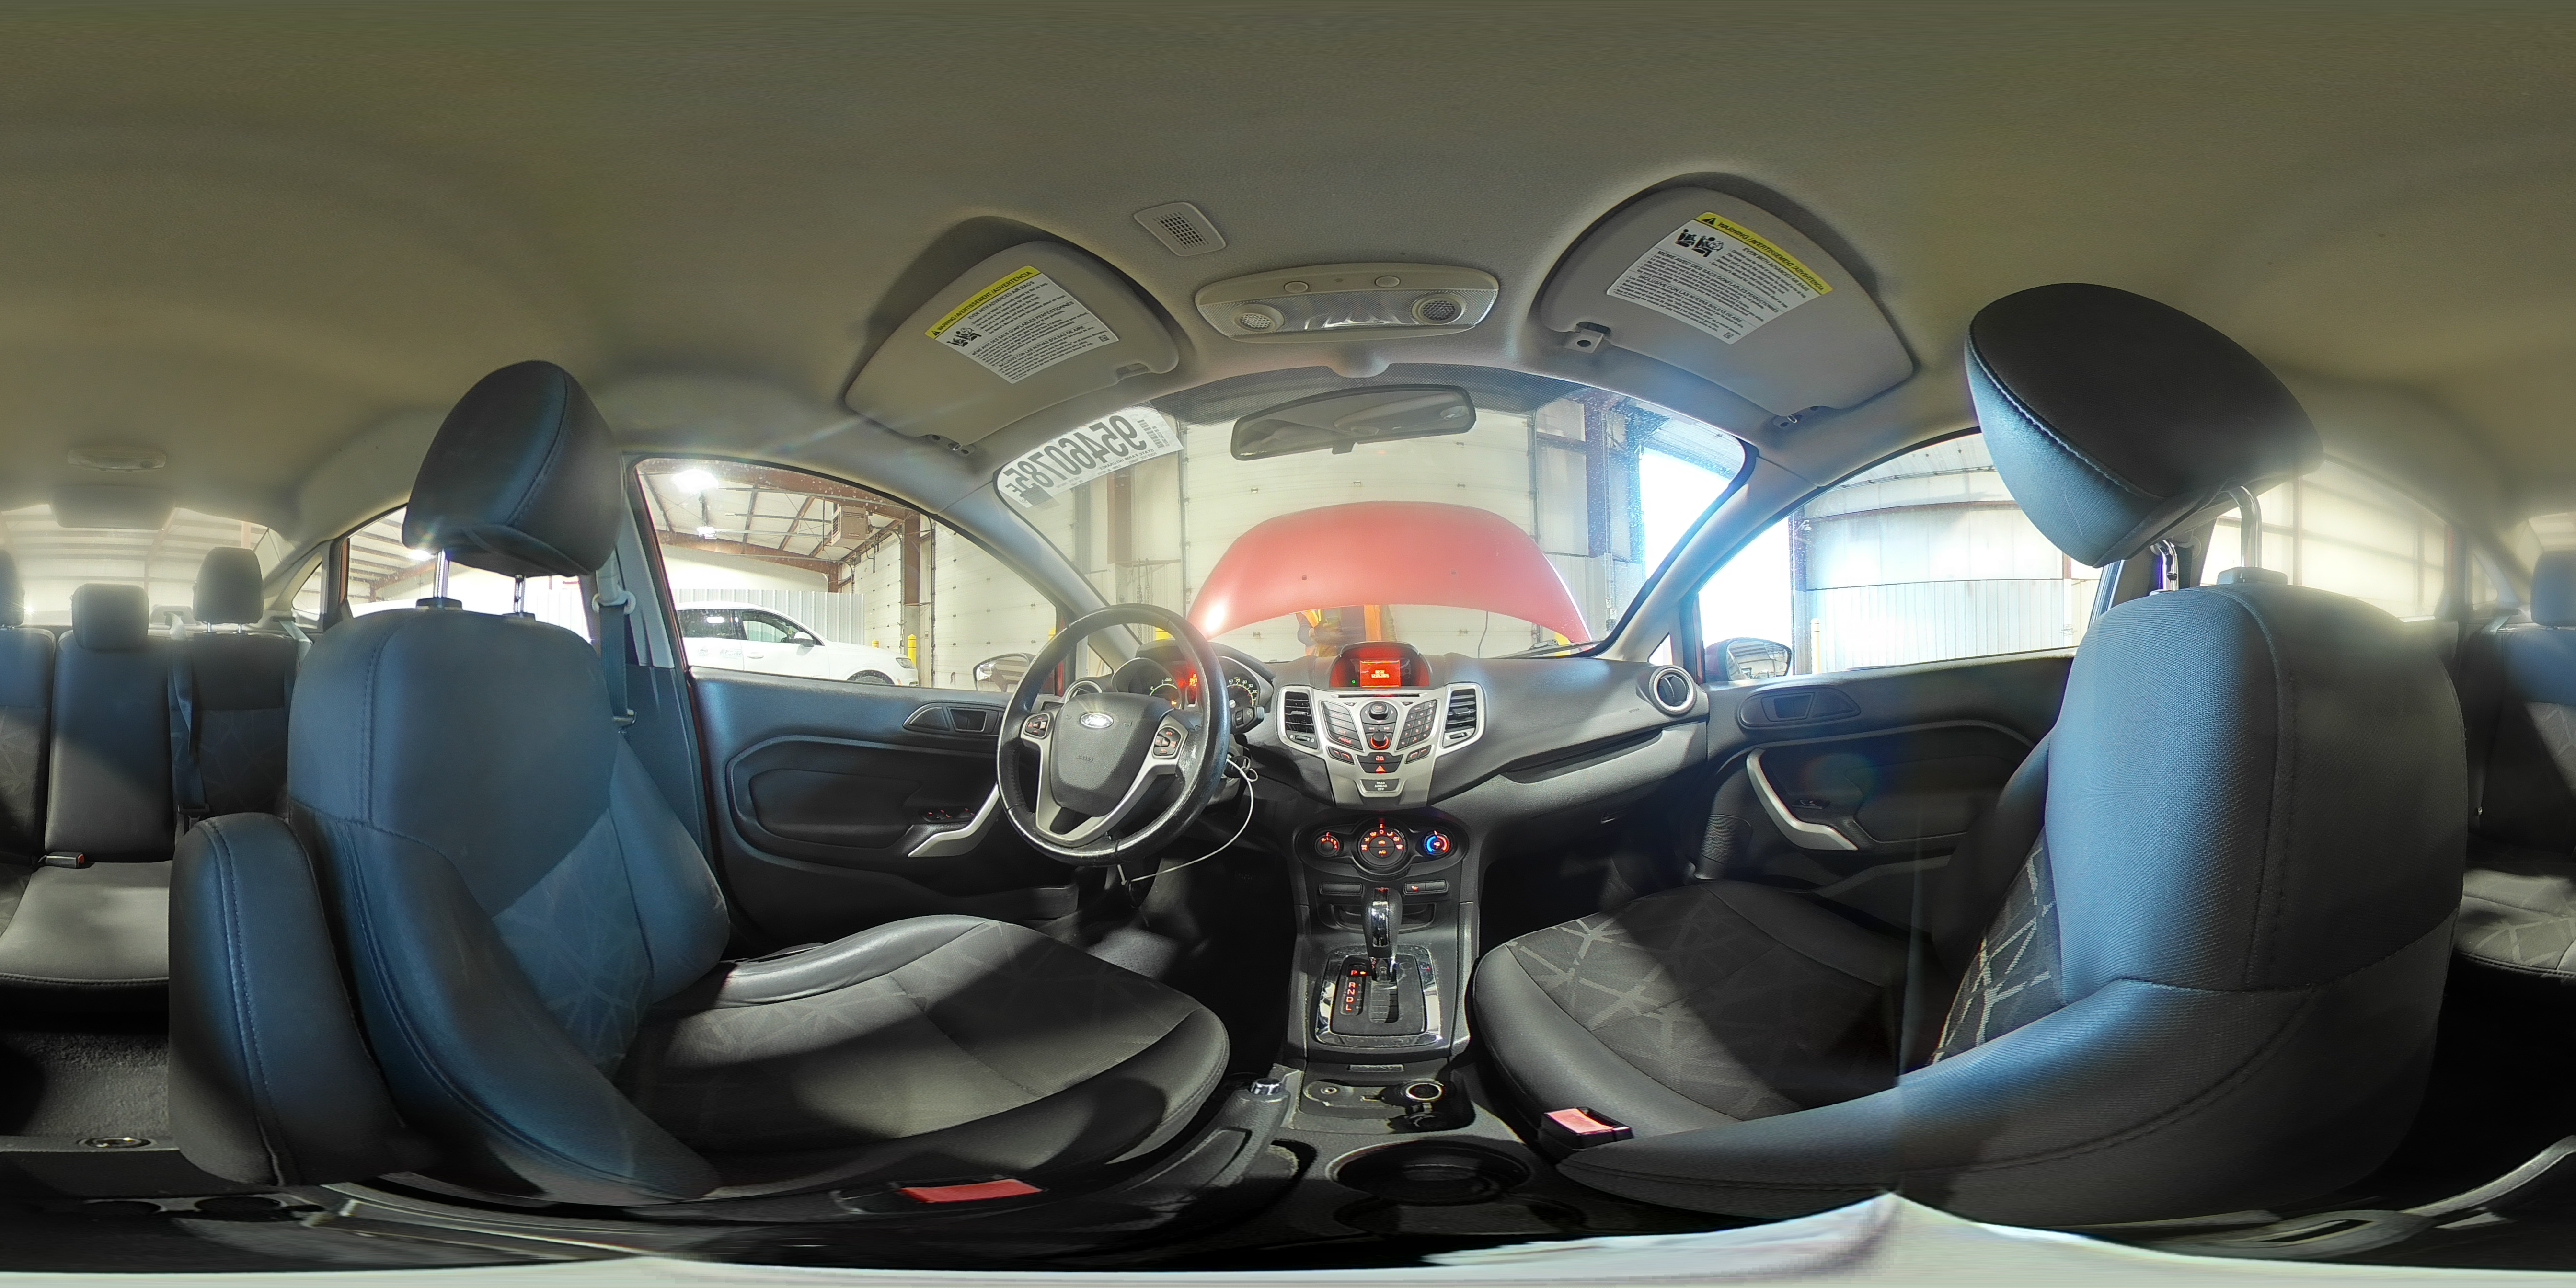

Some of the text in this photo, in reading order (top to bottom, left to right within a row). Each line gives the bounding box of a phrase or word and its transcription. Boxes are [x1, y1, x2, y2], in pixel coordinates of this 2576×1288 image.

[1718, 222, 1749, 240] WARNING
[1742, 247, 1756, 257] EVEN
[1756, 254, 1770, 264] WITH
[1769, 262, 1791, 278] ADVANCED
[1798, 282, 1810, 292] BAGS
[989, 292, 1011, 308] ADVANCED
[1019, 281, 1035, 289] BAGS
[1689, 295, 1709, 305] NUEVAS
[937, 316, 956, 331] WARNING
